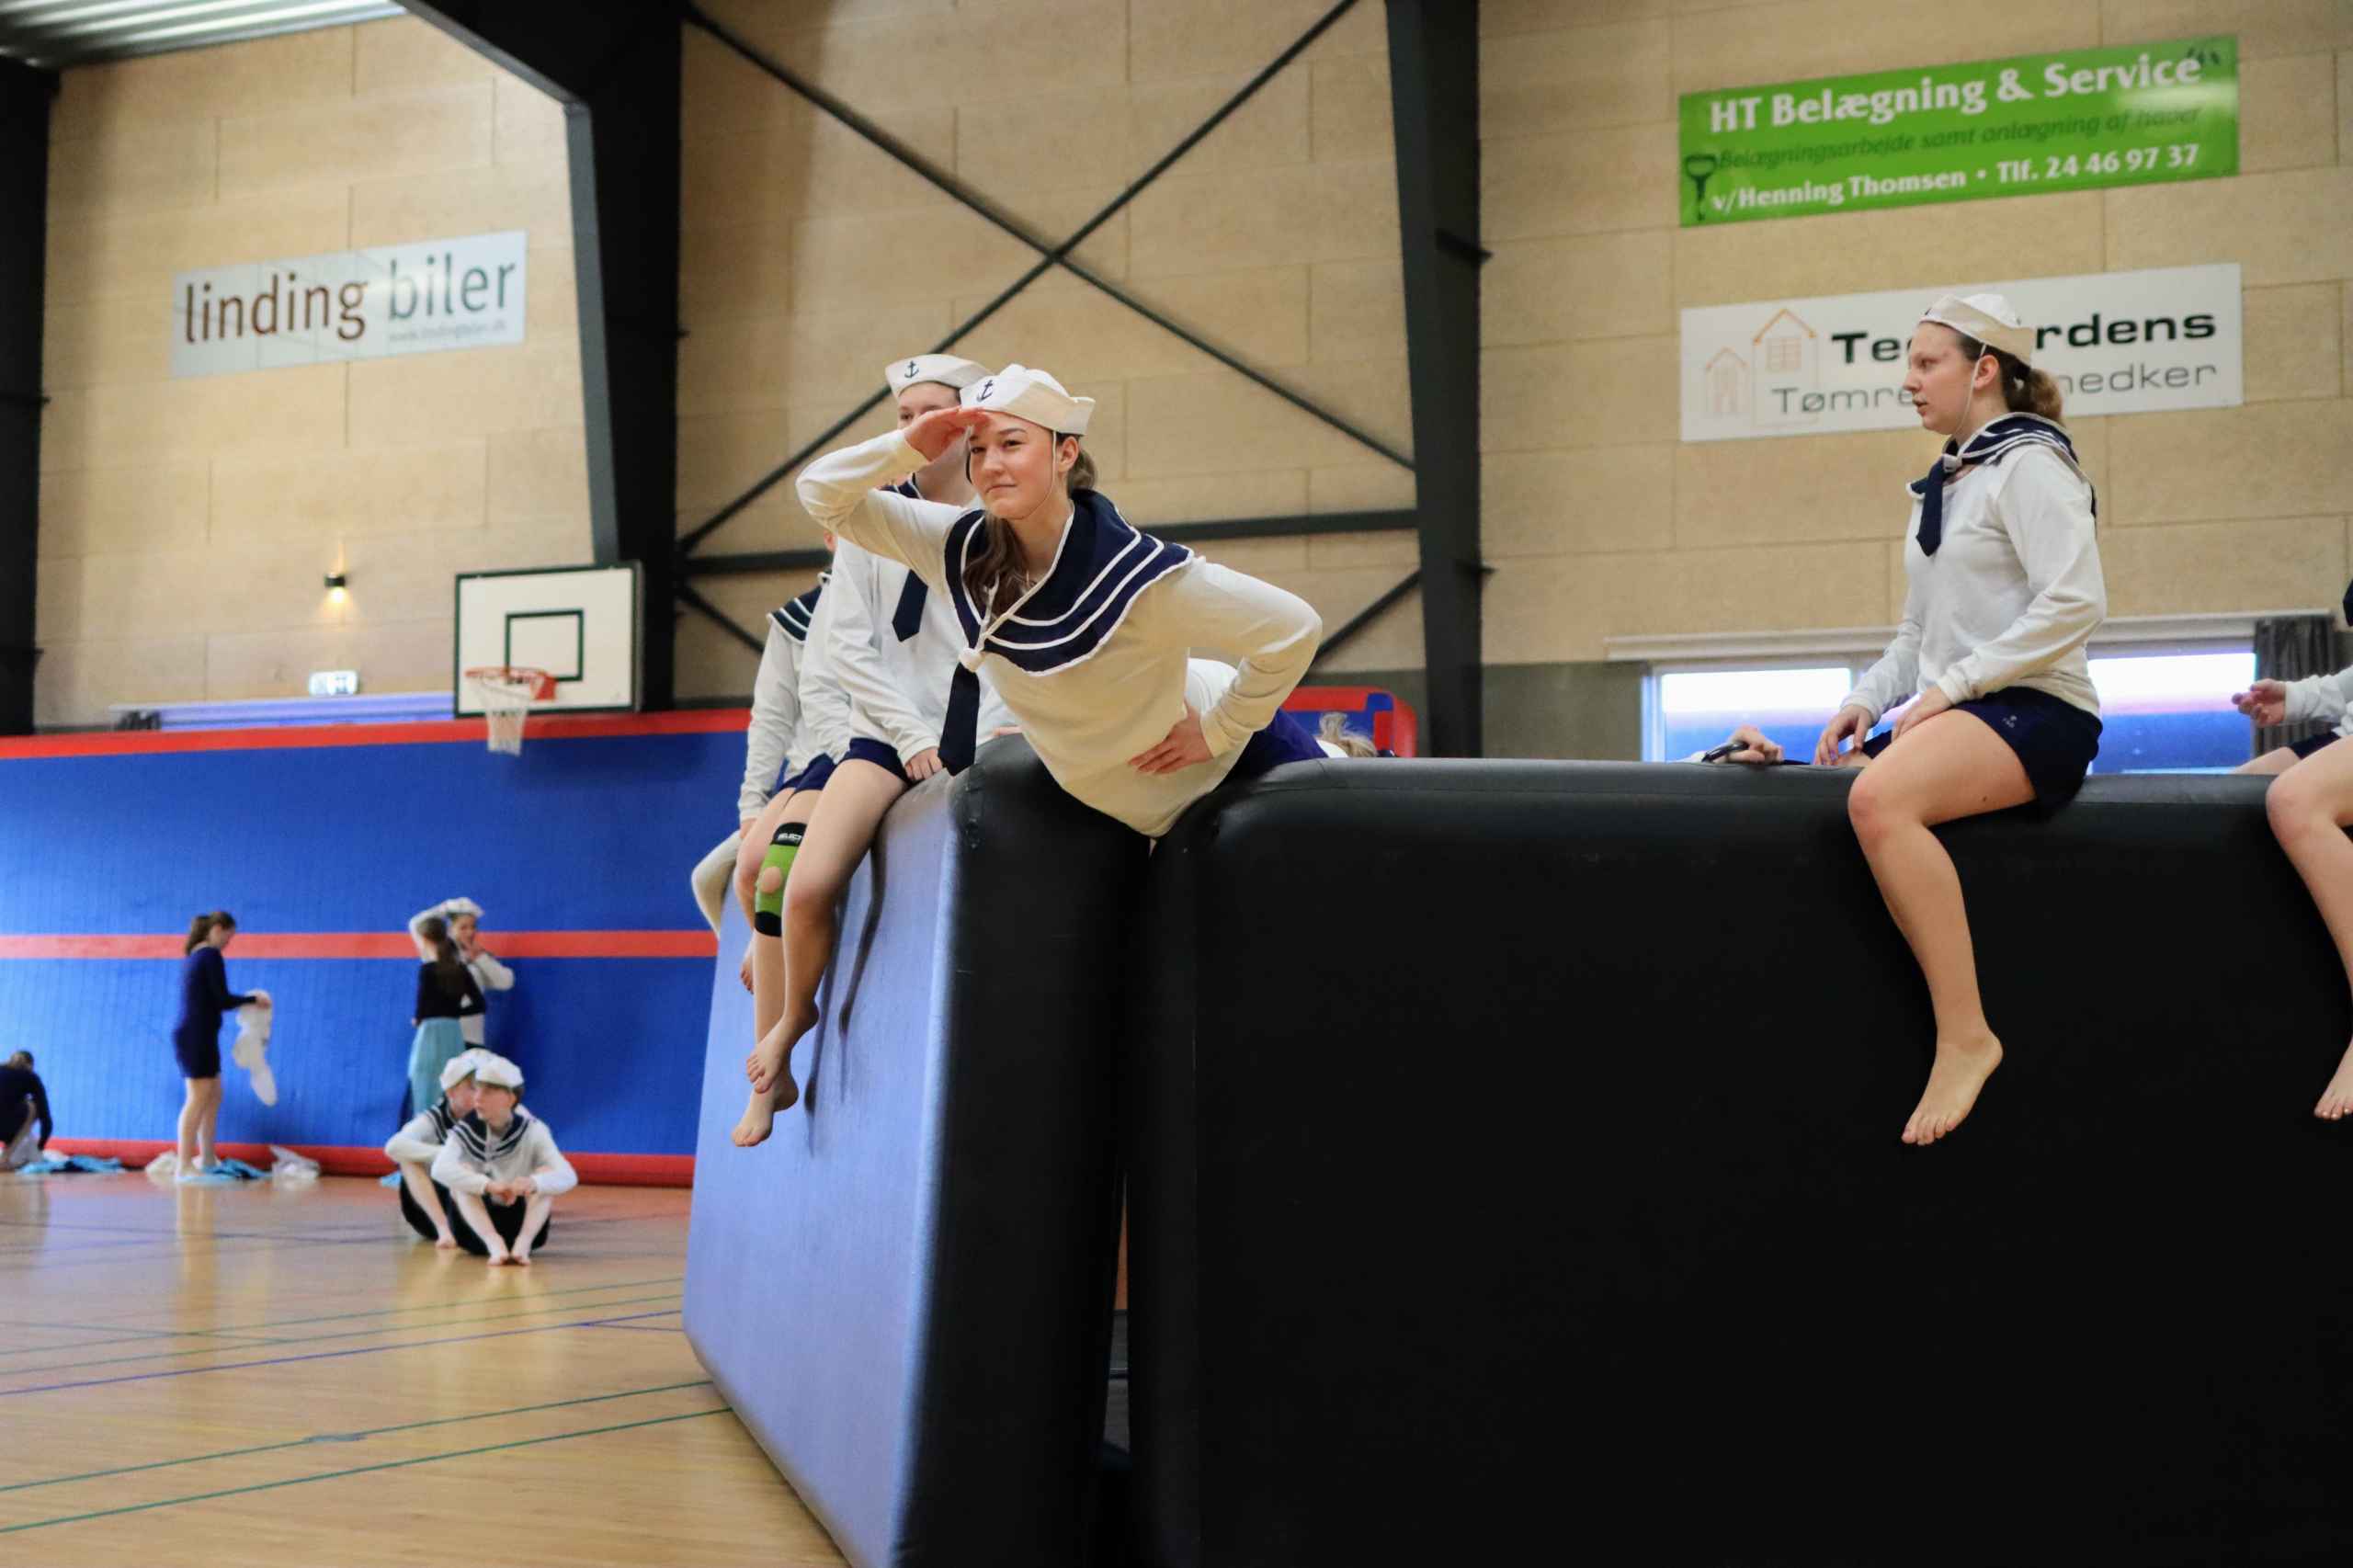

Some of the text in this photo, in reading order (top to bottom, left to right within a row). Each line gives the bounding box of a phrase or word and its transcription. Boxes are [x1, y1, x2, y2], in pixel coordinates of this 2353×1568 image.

[1711, 53, 2201, 133] HT Belægning & Service
[1920, 129, 1974, 149] samt
[1712, 143, 2200, 214] v/Henning Thomsen Tlf. 24 46 97 37
[184, 252, 516, 344] linding biler
